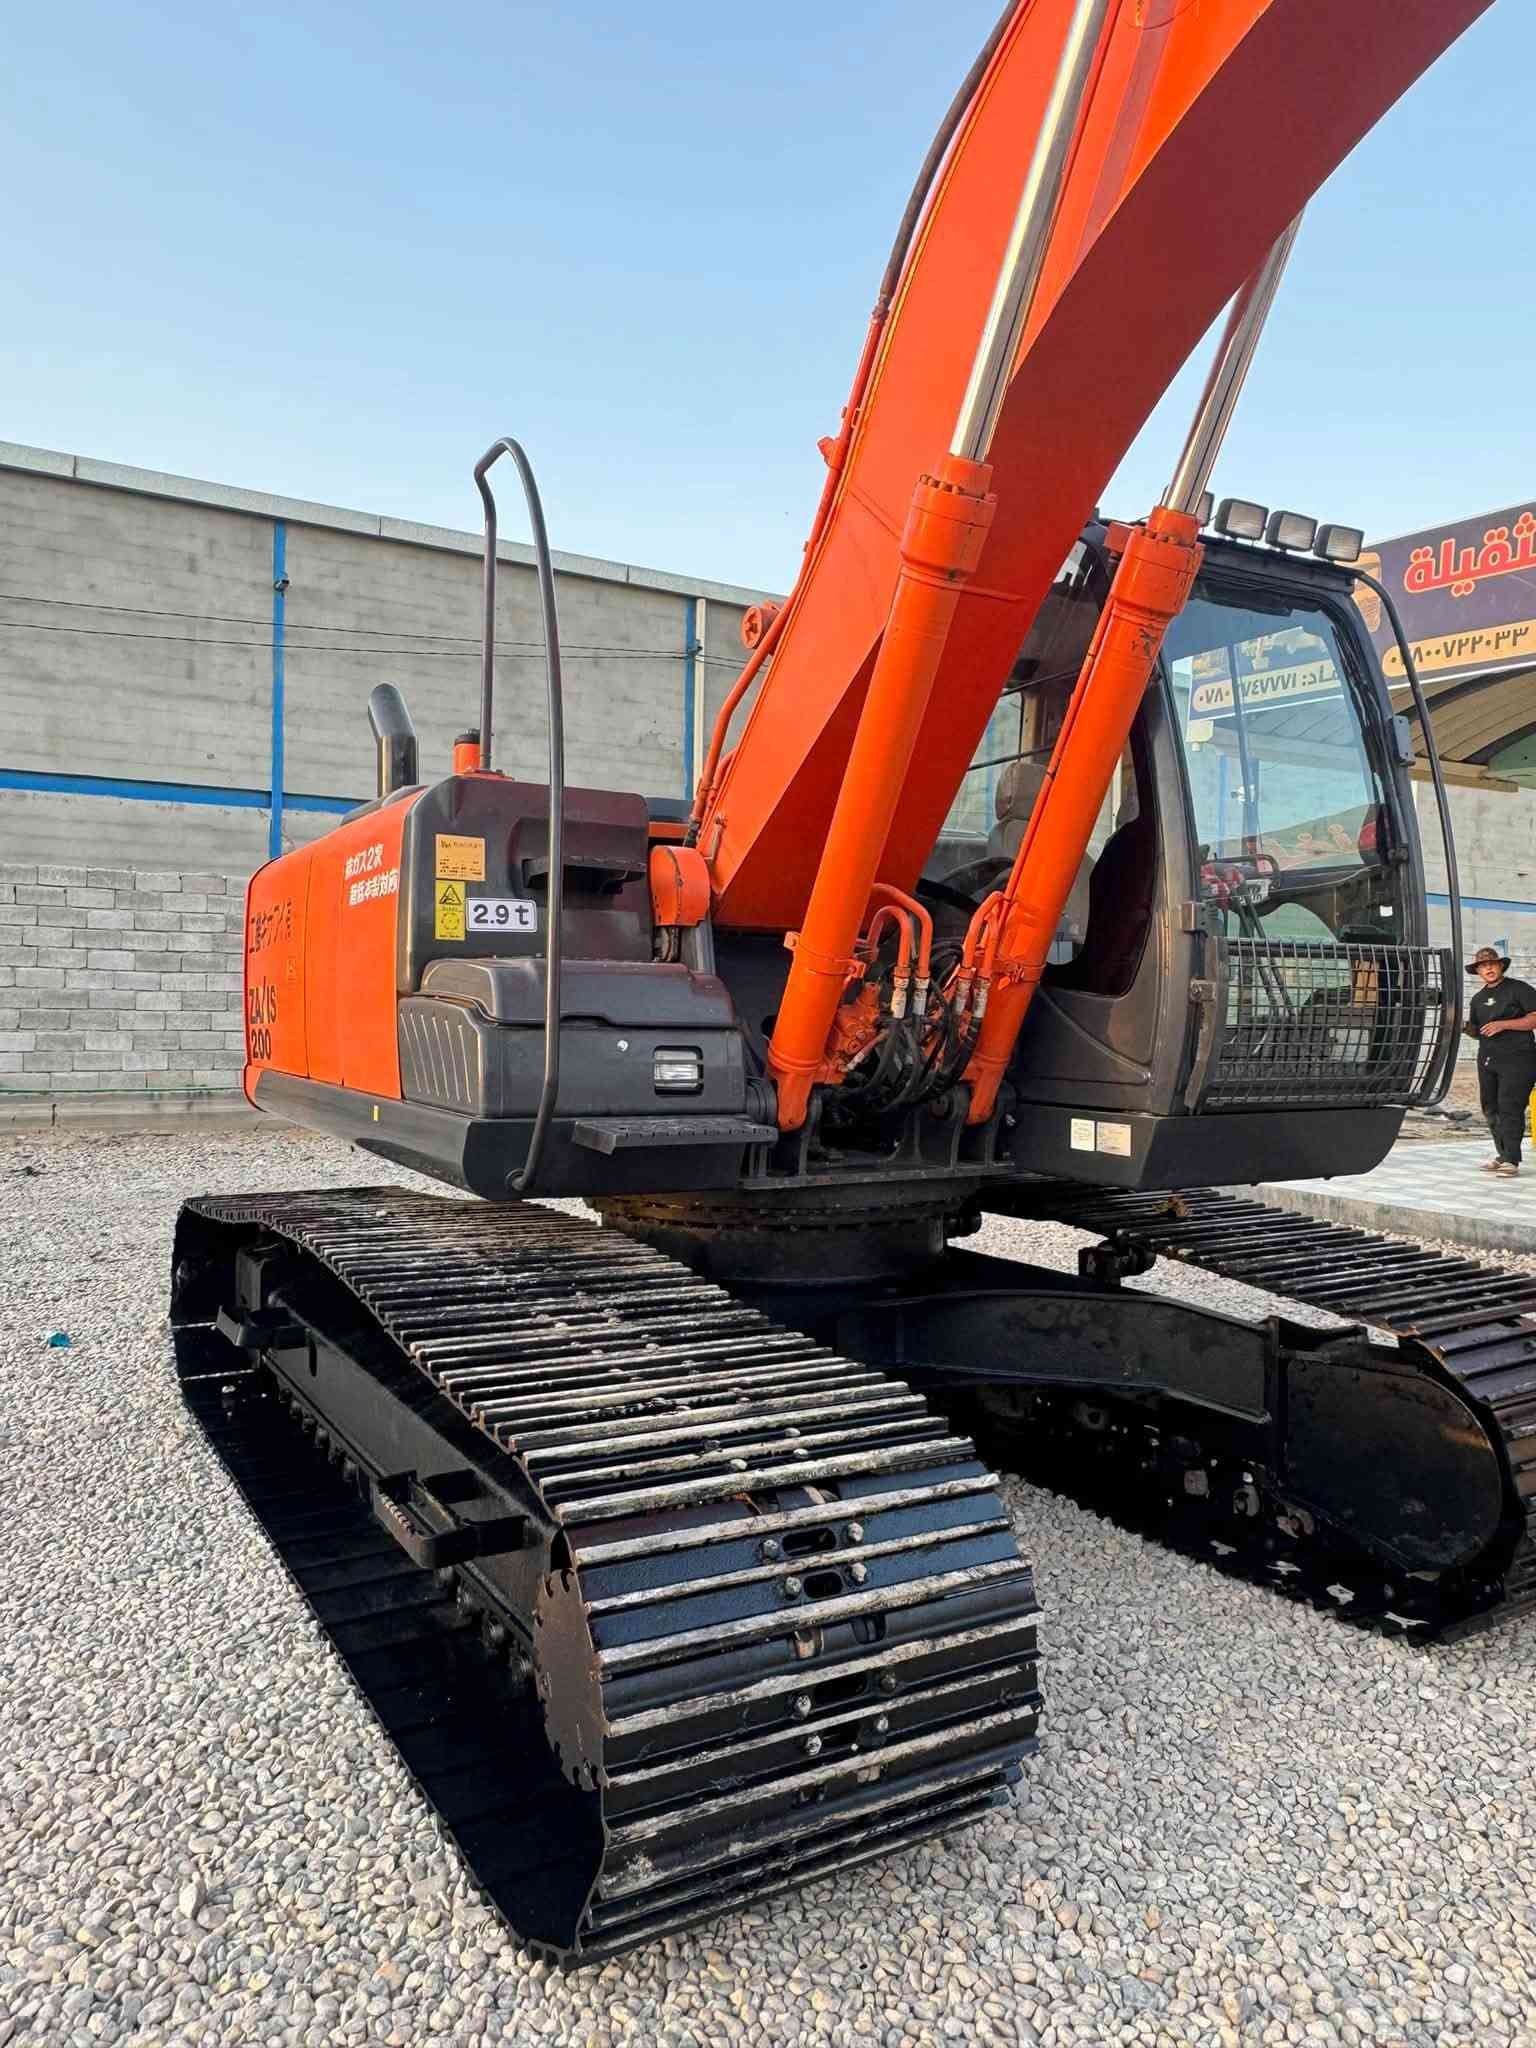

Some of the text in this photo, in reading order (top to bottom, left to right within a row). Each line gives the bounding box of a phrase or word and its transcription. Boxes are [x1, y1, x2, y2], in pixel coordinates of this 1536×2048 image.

[1404, 512, 1536, 598] ثقيلة
[1390, 626, 1529, 665] ٠٨٠٠٧٢٢٠٣٣
[251, 1028, 272, 1060] 200
